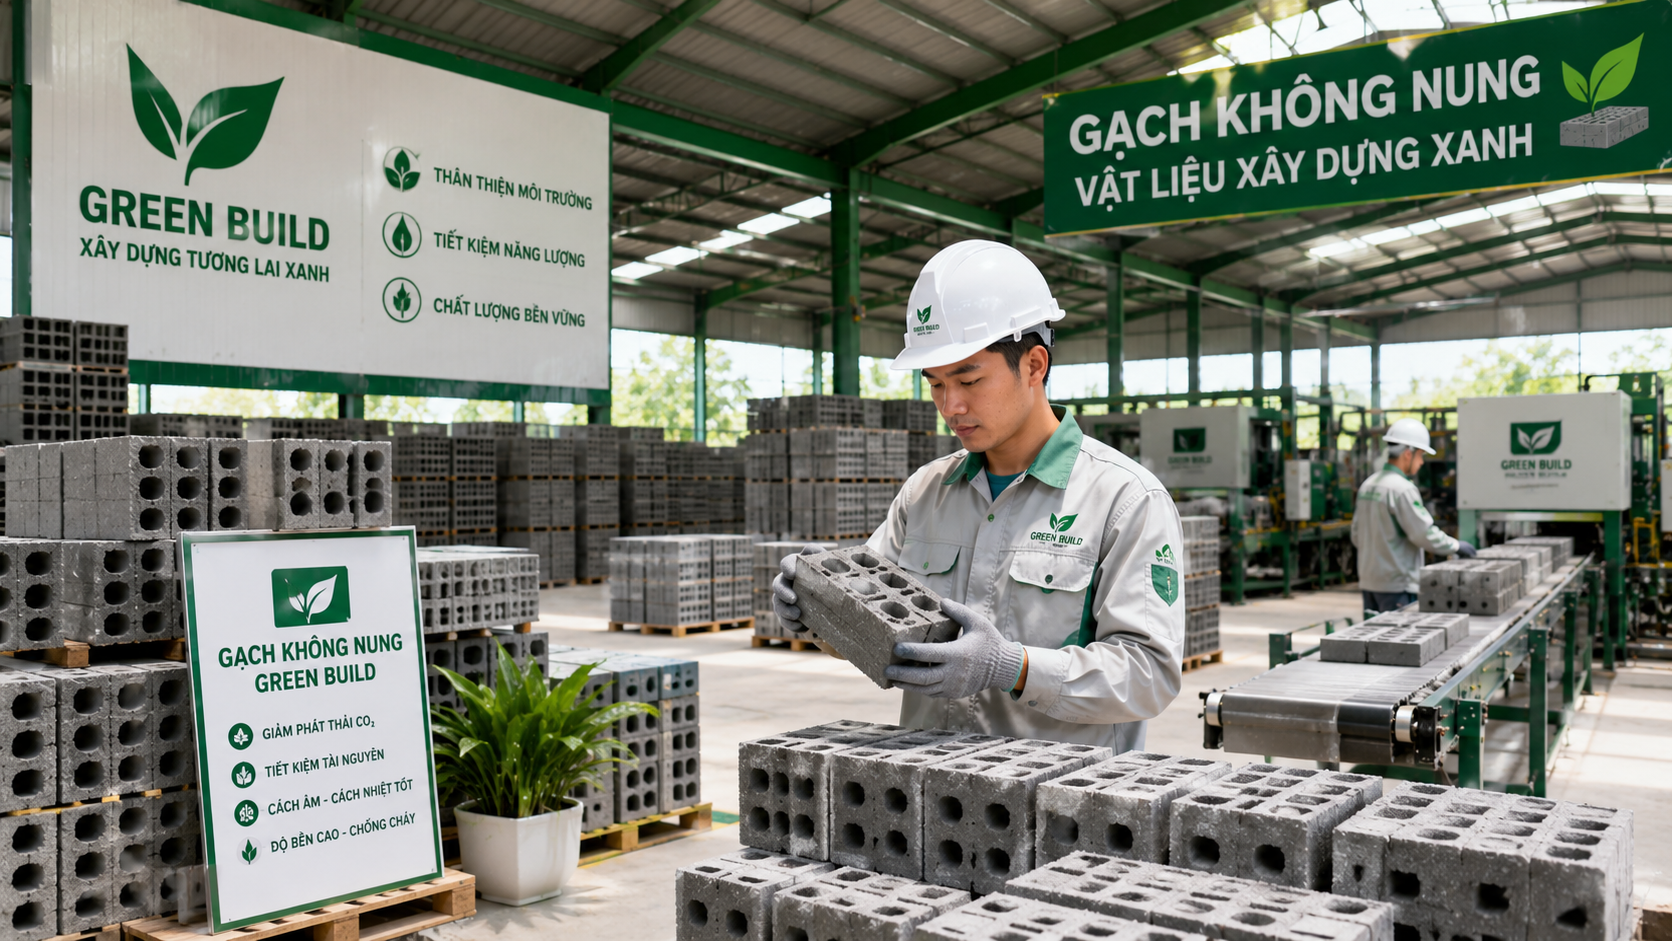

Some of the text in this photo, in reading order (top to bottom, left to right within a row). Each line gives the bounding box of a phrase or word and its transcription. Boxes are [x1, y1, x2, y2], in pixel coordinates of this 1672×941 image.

[1069, 54, 1541, 161] GẠCH KHÔNG NUNG
[1074, 122, 1533, 212] VẬT LIỆU XÂY DỰNG XANH
[433, 167, 593, 211] THÂN THIỆN MÔI TRƯỜNG
[79, 184, 330, 251] GREEN BUILD
[79, 234, 329, 283] XÂY DỰNG TƯƠNG LAI XANH
[433, 229, 586, 269] TIẾT KIỆM NĂNG LƯỢNG
[433, 294, 471, 316] CHẤT
[474, 302, 520, 323] LƯỢNG
[552, 309, 586, 328] VỮNG
[1501, 459, 1572, 470] GREEN BUILD
[1030, 531, 1057, 543] GREEN
[218, 633, 403, 671] GẠCH KHÔNG NUNG
[254, 662, 376, 693] GREEN BUILD
[296, 718, 326, 736] PHÁT
[264, 760, 290, 778] TIẾT
[322, 753, 339, 769] TÀI
[267, 798, 300, 815] CÁCH
[303, 794, 321, 809] ÂM
[331, 788, 360, 804] CÁCH
[363, 781, 392, 798] NHIỆT
[291, 830, 314, 849] BỀN
[316, 828, 340, 844] CAO
[349, 817, 387, 836] CHỐNG
